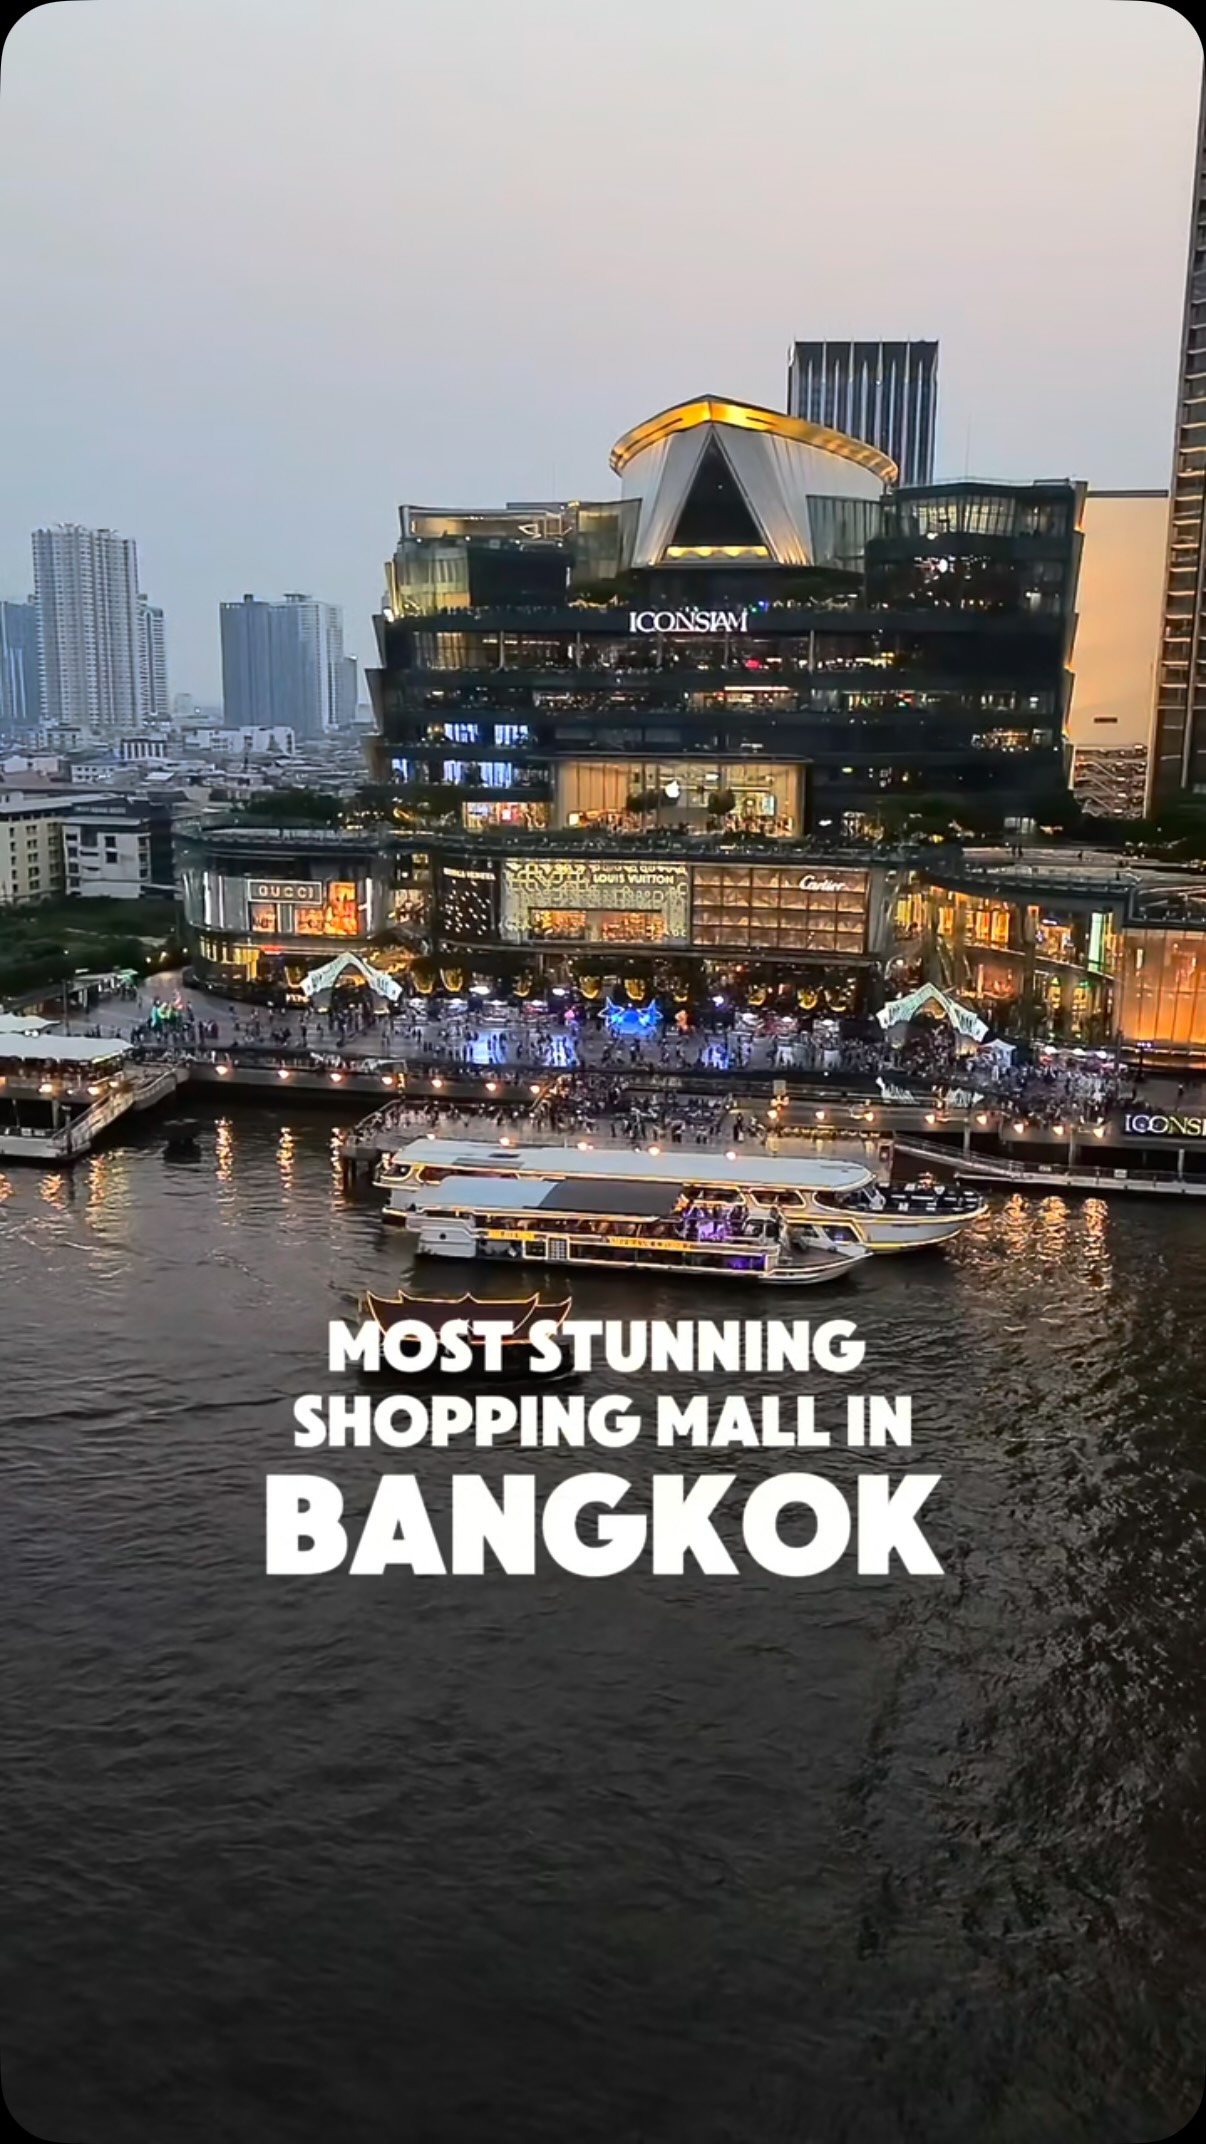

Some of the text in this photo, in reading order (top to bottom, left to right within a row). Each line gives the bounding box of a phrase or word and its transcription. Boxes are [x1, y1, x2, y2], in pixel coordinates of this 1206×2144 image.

[629, 611, 748, 633] ICONSIAM
[593, 873, 674, 884] LOUIS VUITTON
[799, 874, 846, 892] Cartier
[258, 885, 314, 899] GUCCI
